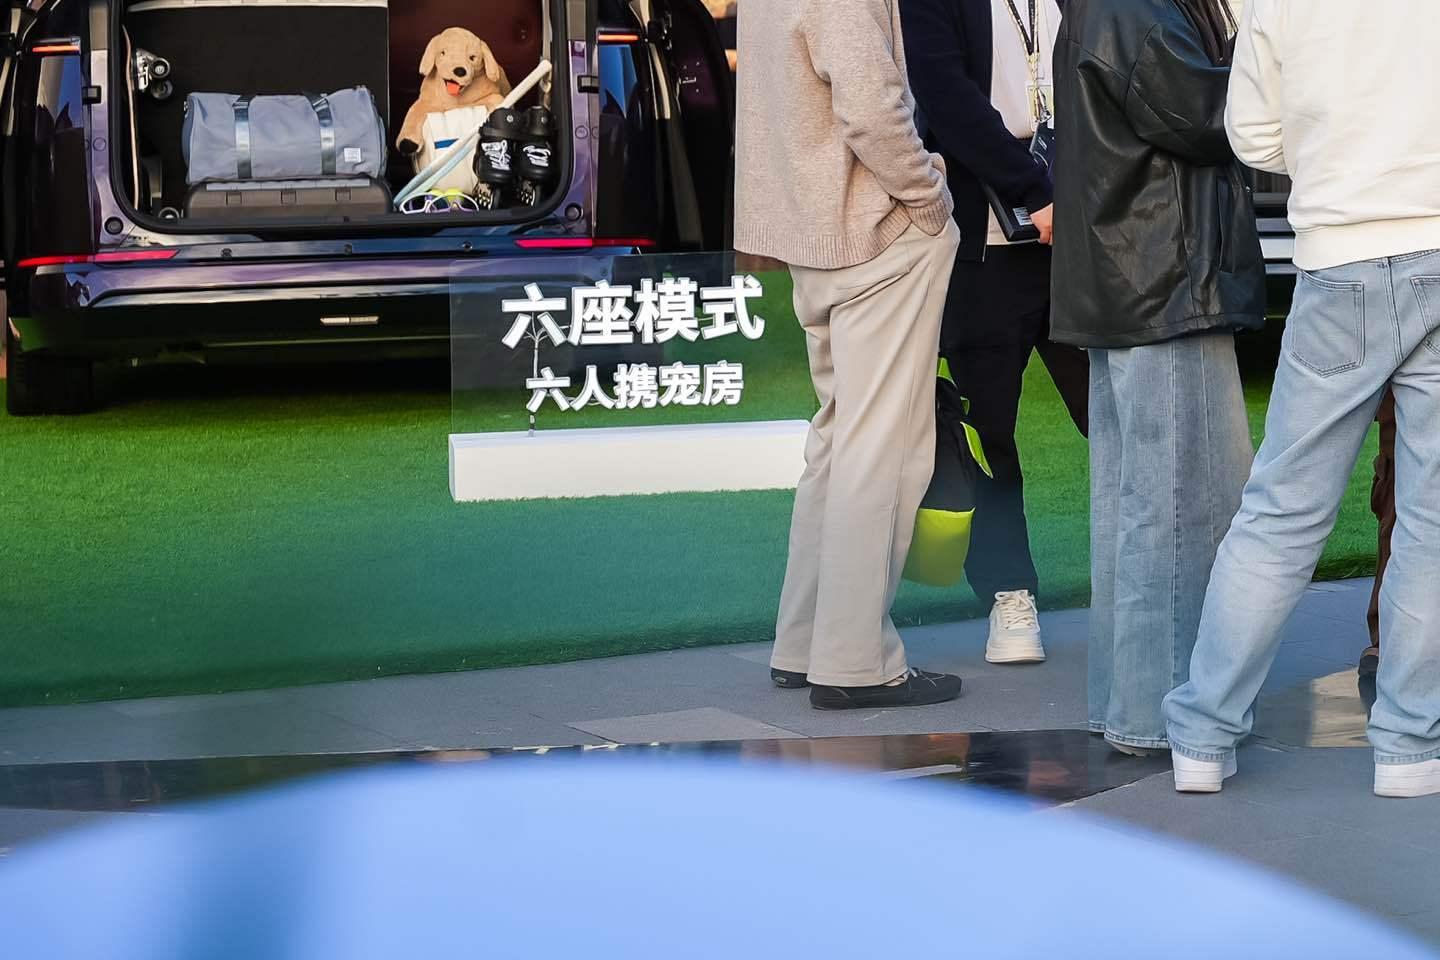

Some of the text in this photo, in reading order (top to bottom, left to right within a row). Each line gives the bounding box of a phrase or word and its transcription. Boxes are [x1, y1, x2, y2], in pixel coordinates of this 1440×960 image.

[501, 274, 766, 350] 六座模式
[525, 360, 744, 413] 六人携宠房
